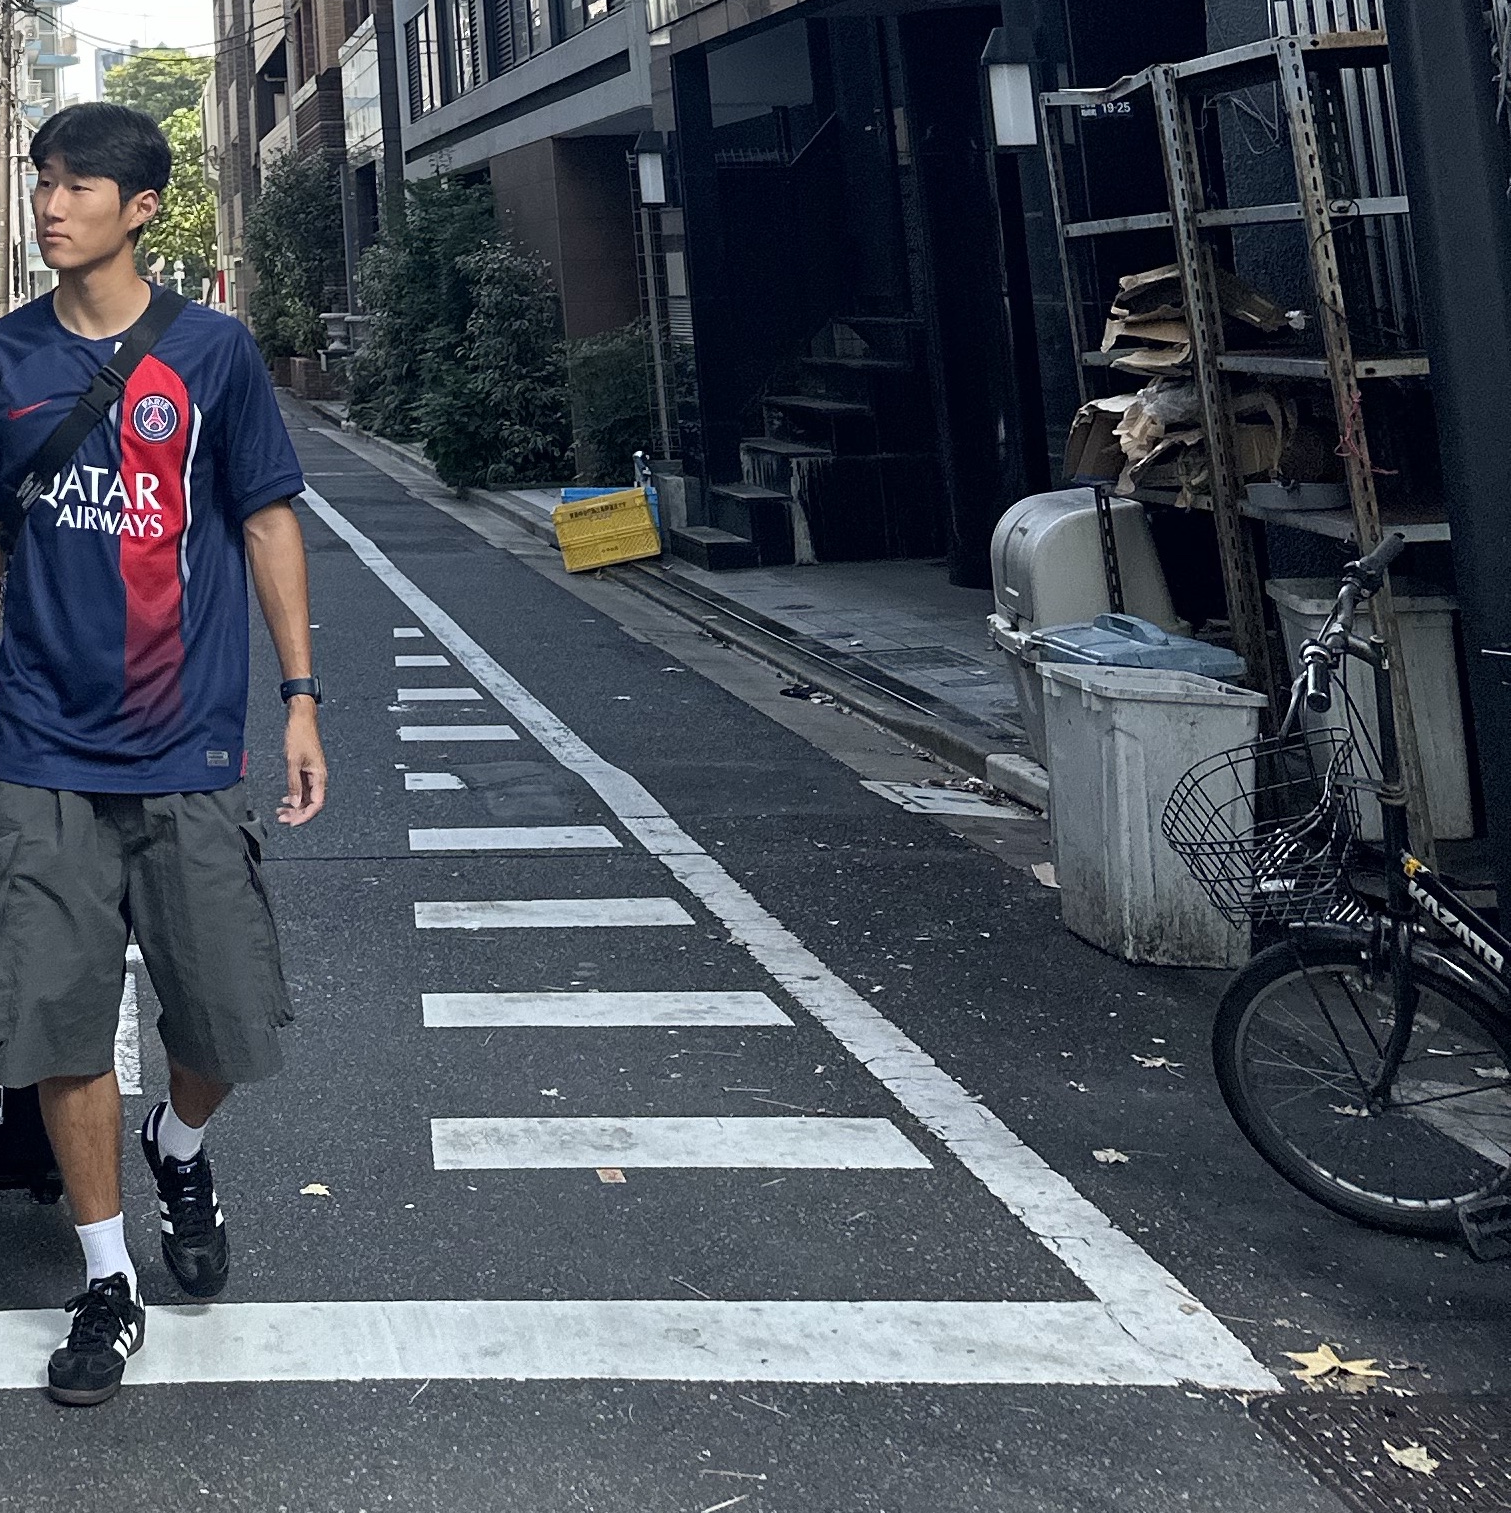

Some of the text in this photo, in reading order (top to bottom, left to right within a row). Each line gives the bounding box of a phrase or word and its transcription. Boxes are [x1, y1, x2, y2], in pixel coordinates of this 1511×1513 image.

[142, 396, 170, 411] PARIS
[56, 504, 164, 538] AIRWAYS
[1408, 878, 1504, 974] KAZATO
